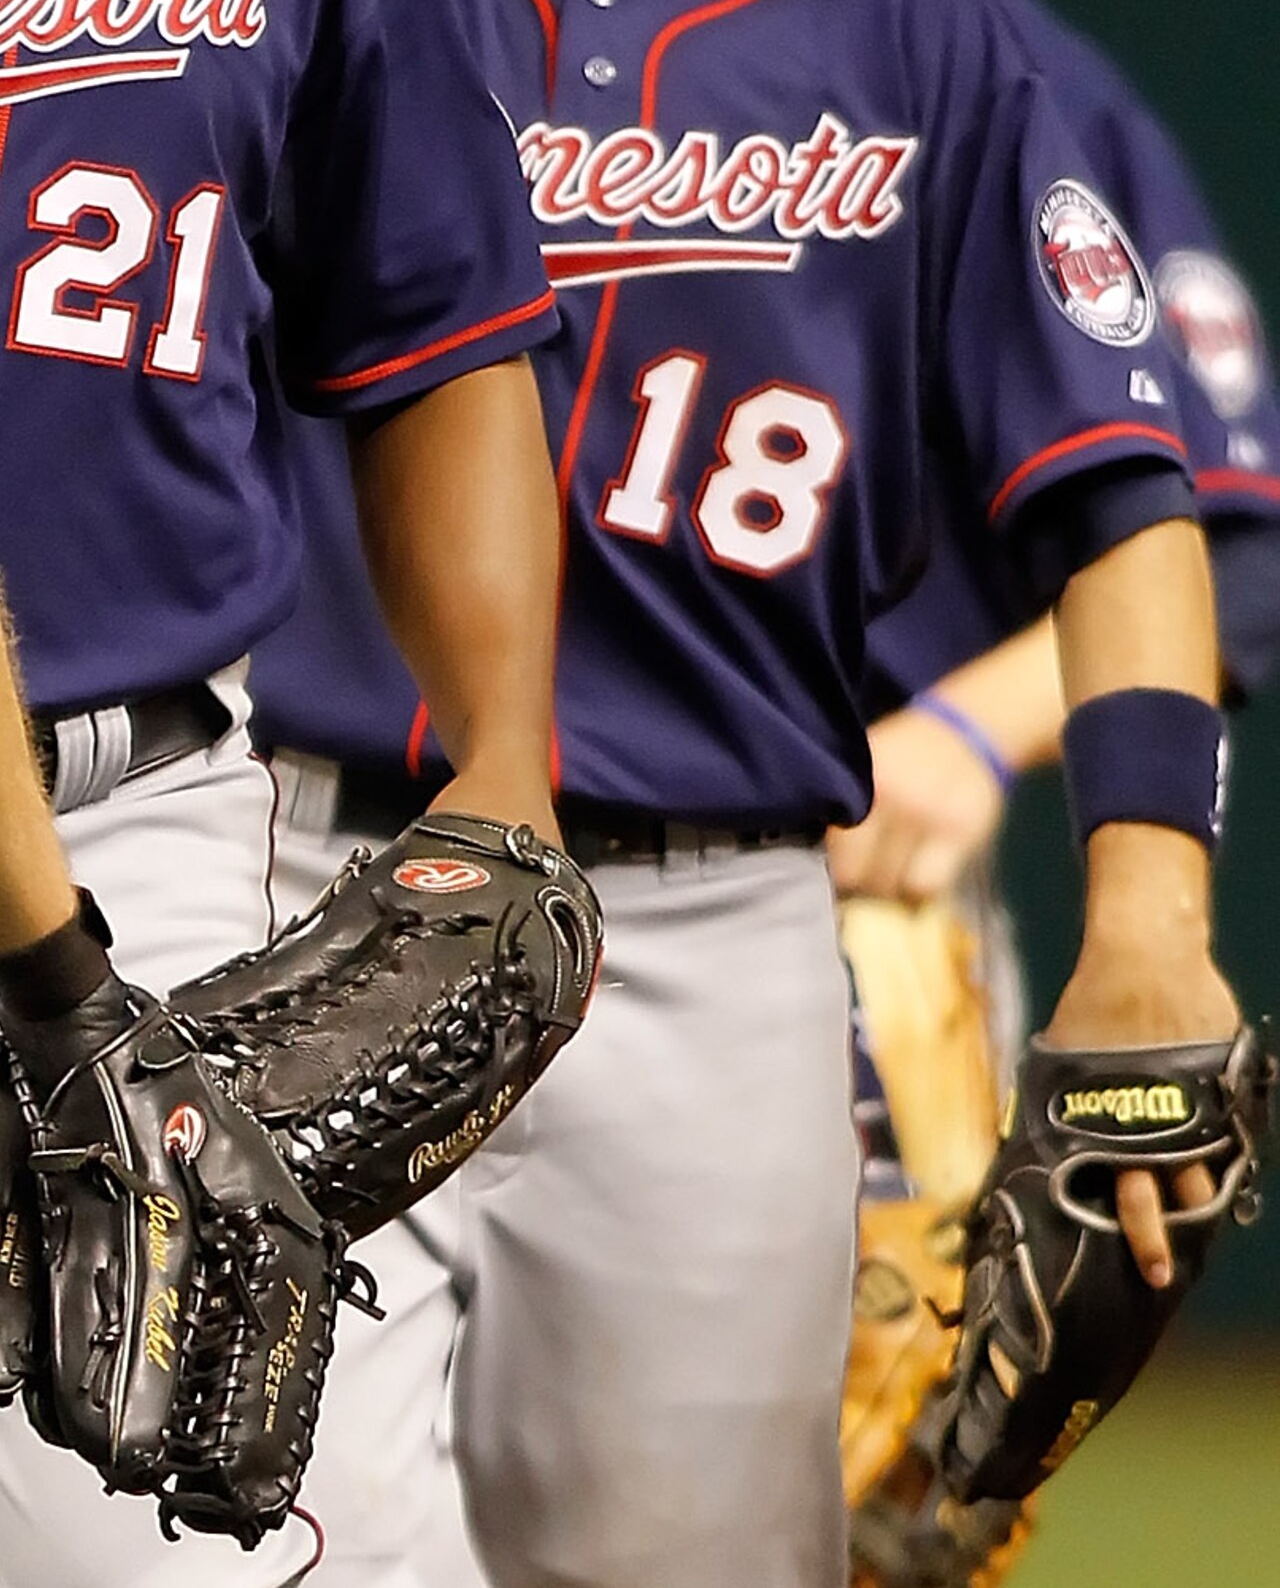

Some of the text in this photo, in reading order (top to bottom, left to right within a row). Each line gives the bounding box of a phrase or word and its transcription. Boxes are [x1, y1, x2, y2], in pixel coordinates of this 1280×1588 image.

[6, 160, 227, 383] 21
[597, 347, 851, 578] 18
[1062, 1085, 1188, 1122] Wilson
[143, 1194, 182, 1373] Jason Kubel
